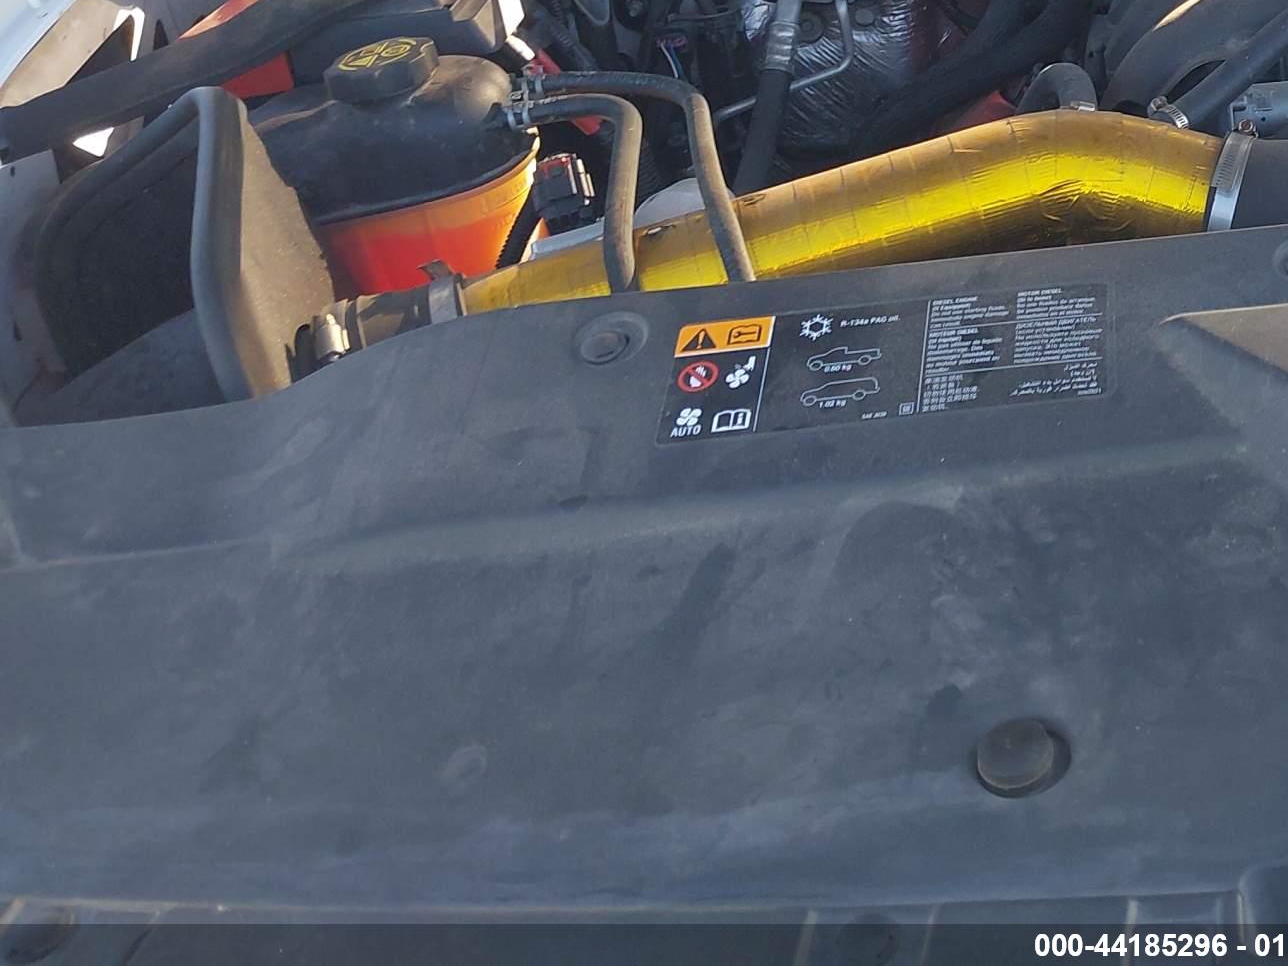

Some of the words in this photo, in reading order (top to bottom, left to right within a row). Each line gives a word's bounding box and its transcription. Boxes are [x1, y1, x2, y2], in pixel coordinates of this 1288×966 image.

[870, 316, 887, 324] PAG
[836, 399, 847, 407] kg
[669, 424, 702, 438] AUTO
